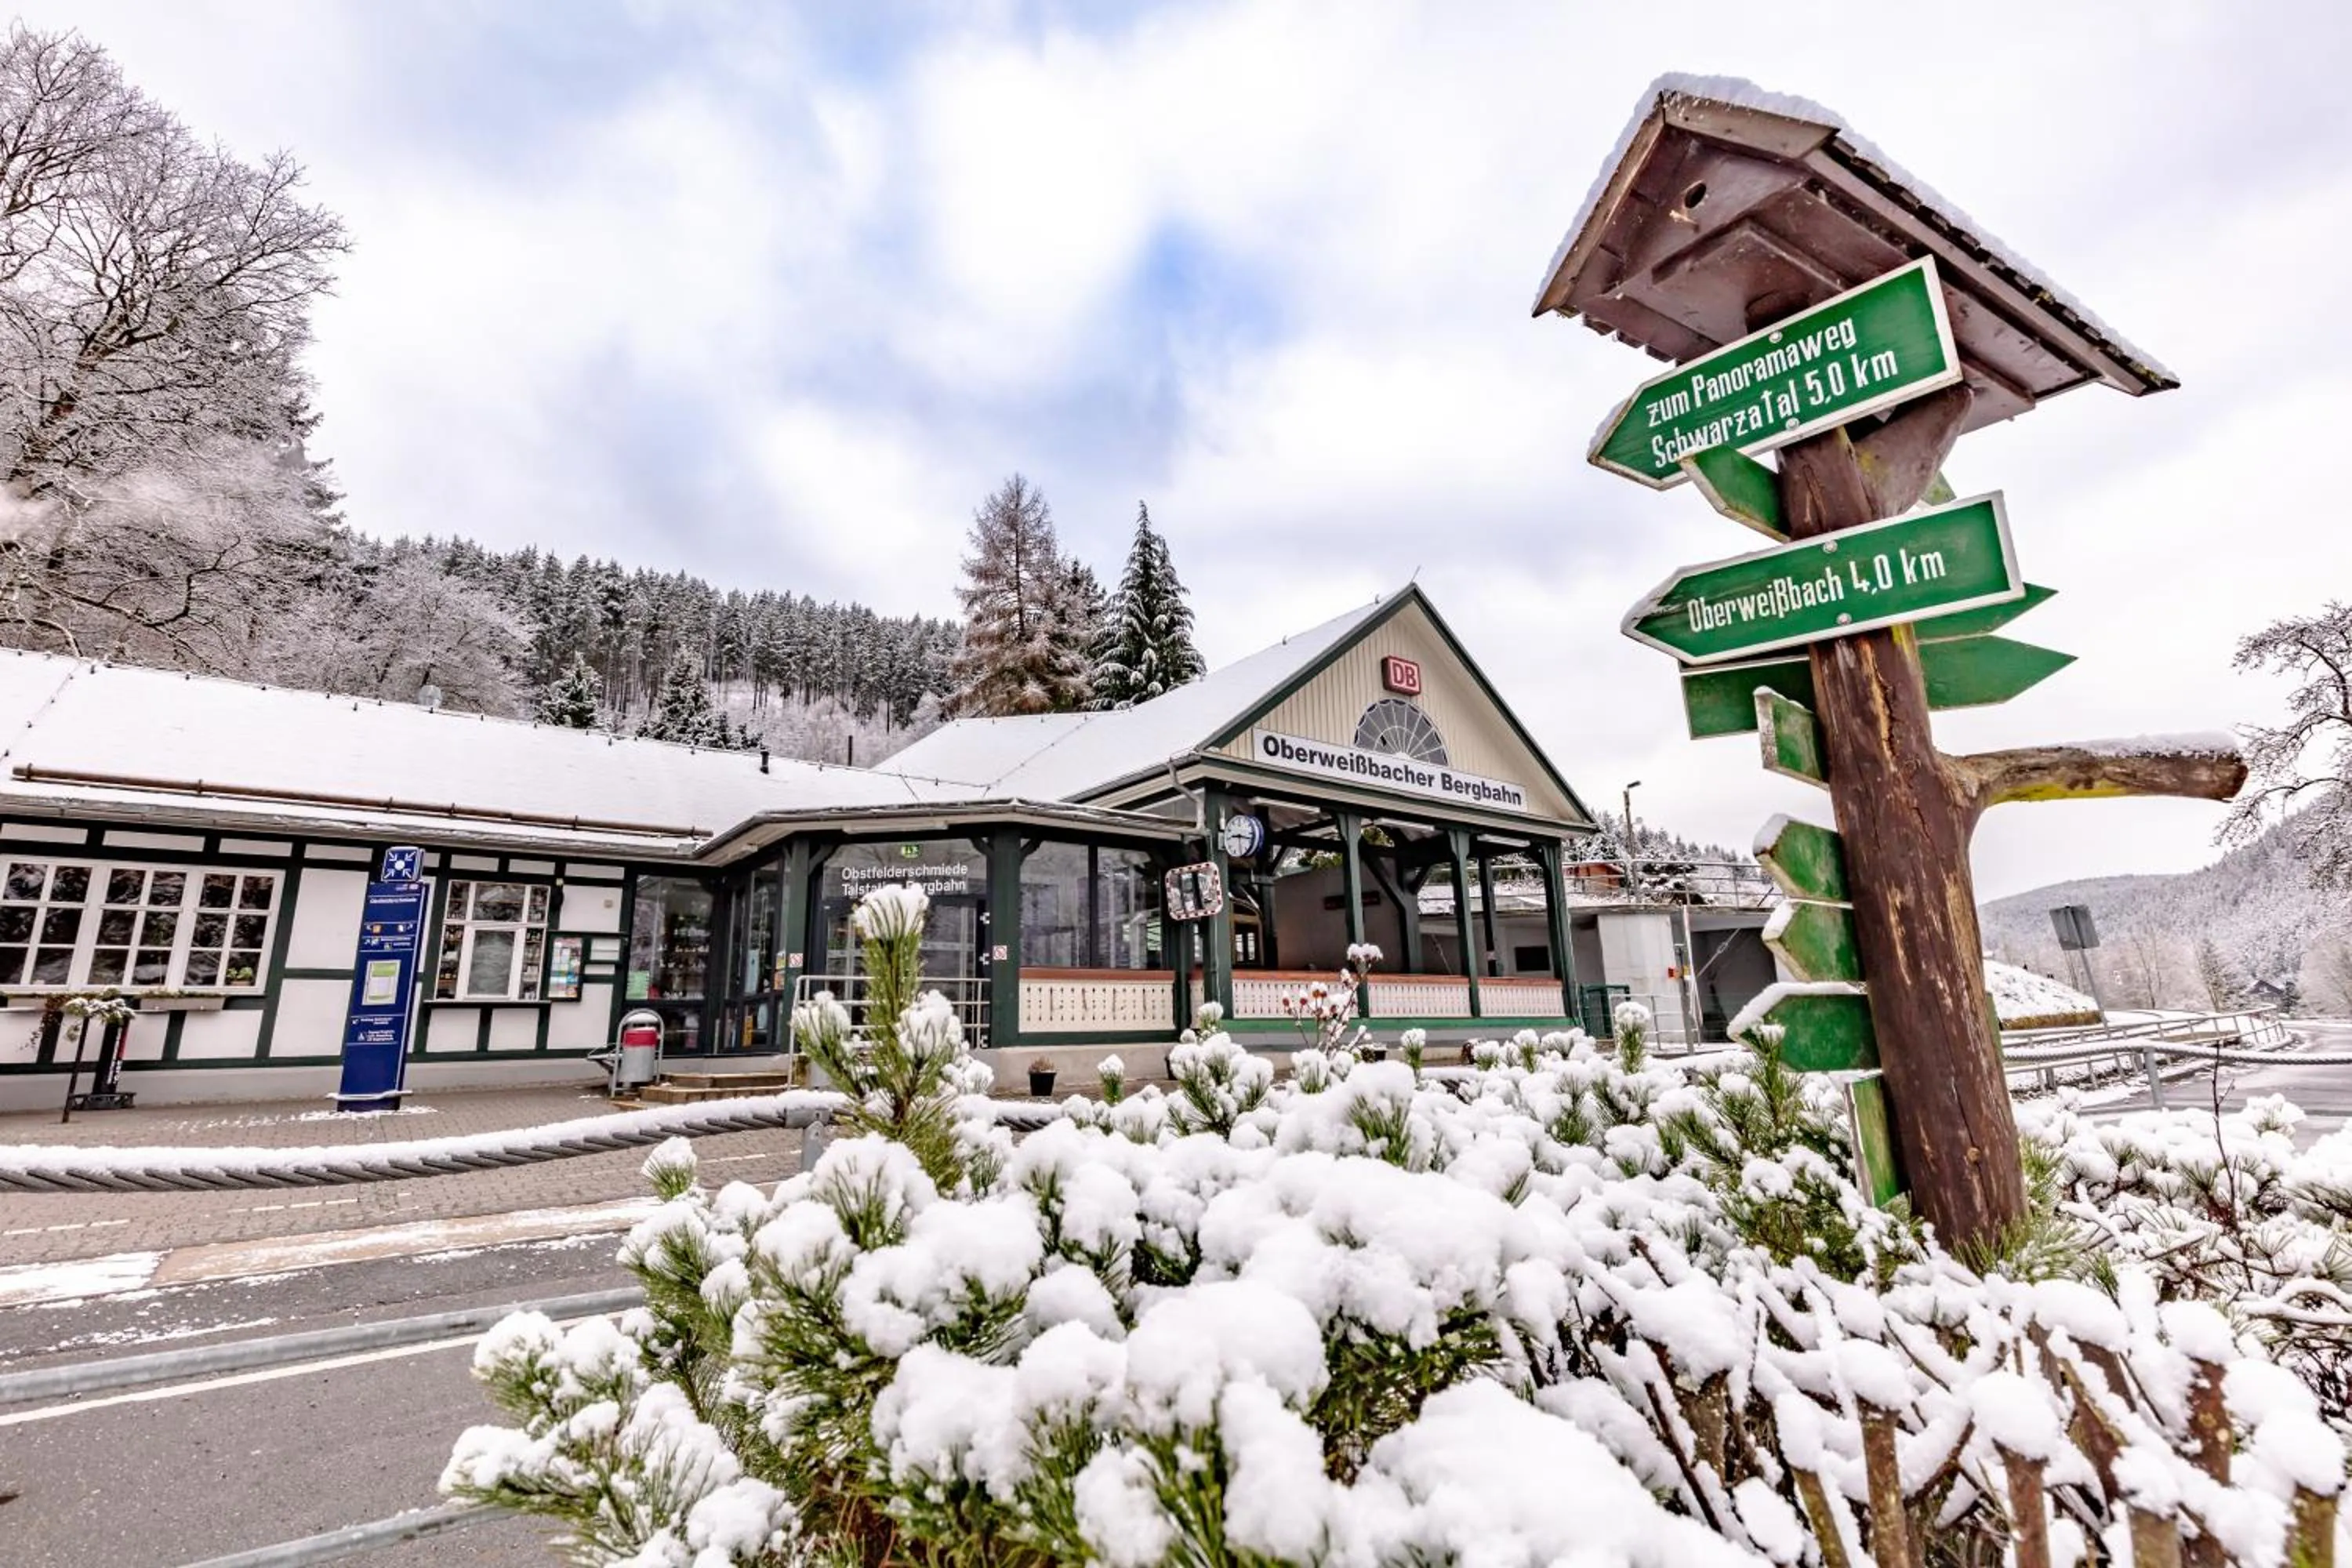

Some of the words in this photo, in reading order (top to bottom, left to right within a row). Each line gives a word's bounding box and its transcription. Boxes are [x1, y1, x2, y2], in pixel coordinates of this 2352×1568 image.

[1646, 390, 1691, 428] zum
[1692, 317, 1857, 408] Panoramaweg
[1805, 361, 1846, 406] 5,0
[1850, 350, 1899, 389] km
[1686, 566, 1844, 633] Oberweißbach
[1849, 554, 1893, 597] 4,0
[1899, 548, 1947, 585] km
[1392, 662, 1417, 688] DB
[1262, 735, 1436, 788] Oberweißbacher
[1440, 772, 1523, 806] Bergbahn
[841, 862, 969, 880] Obstfelderschmiede
[906, 878, 966, 896] Brgbahn
